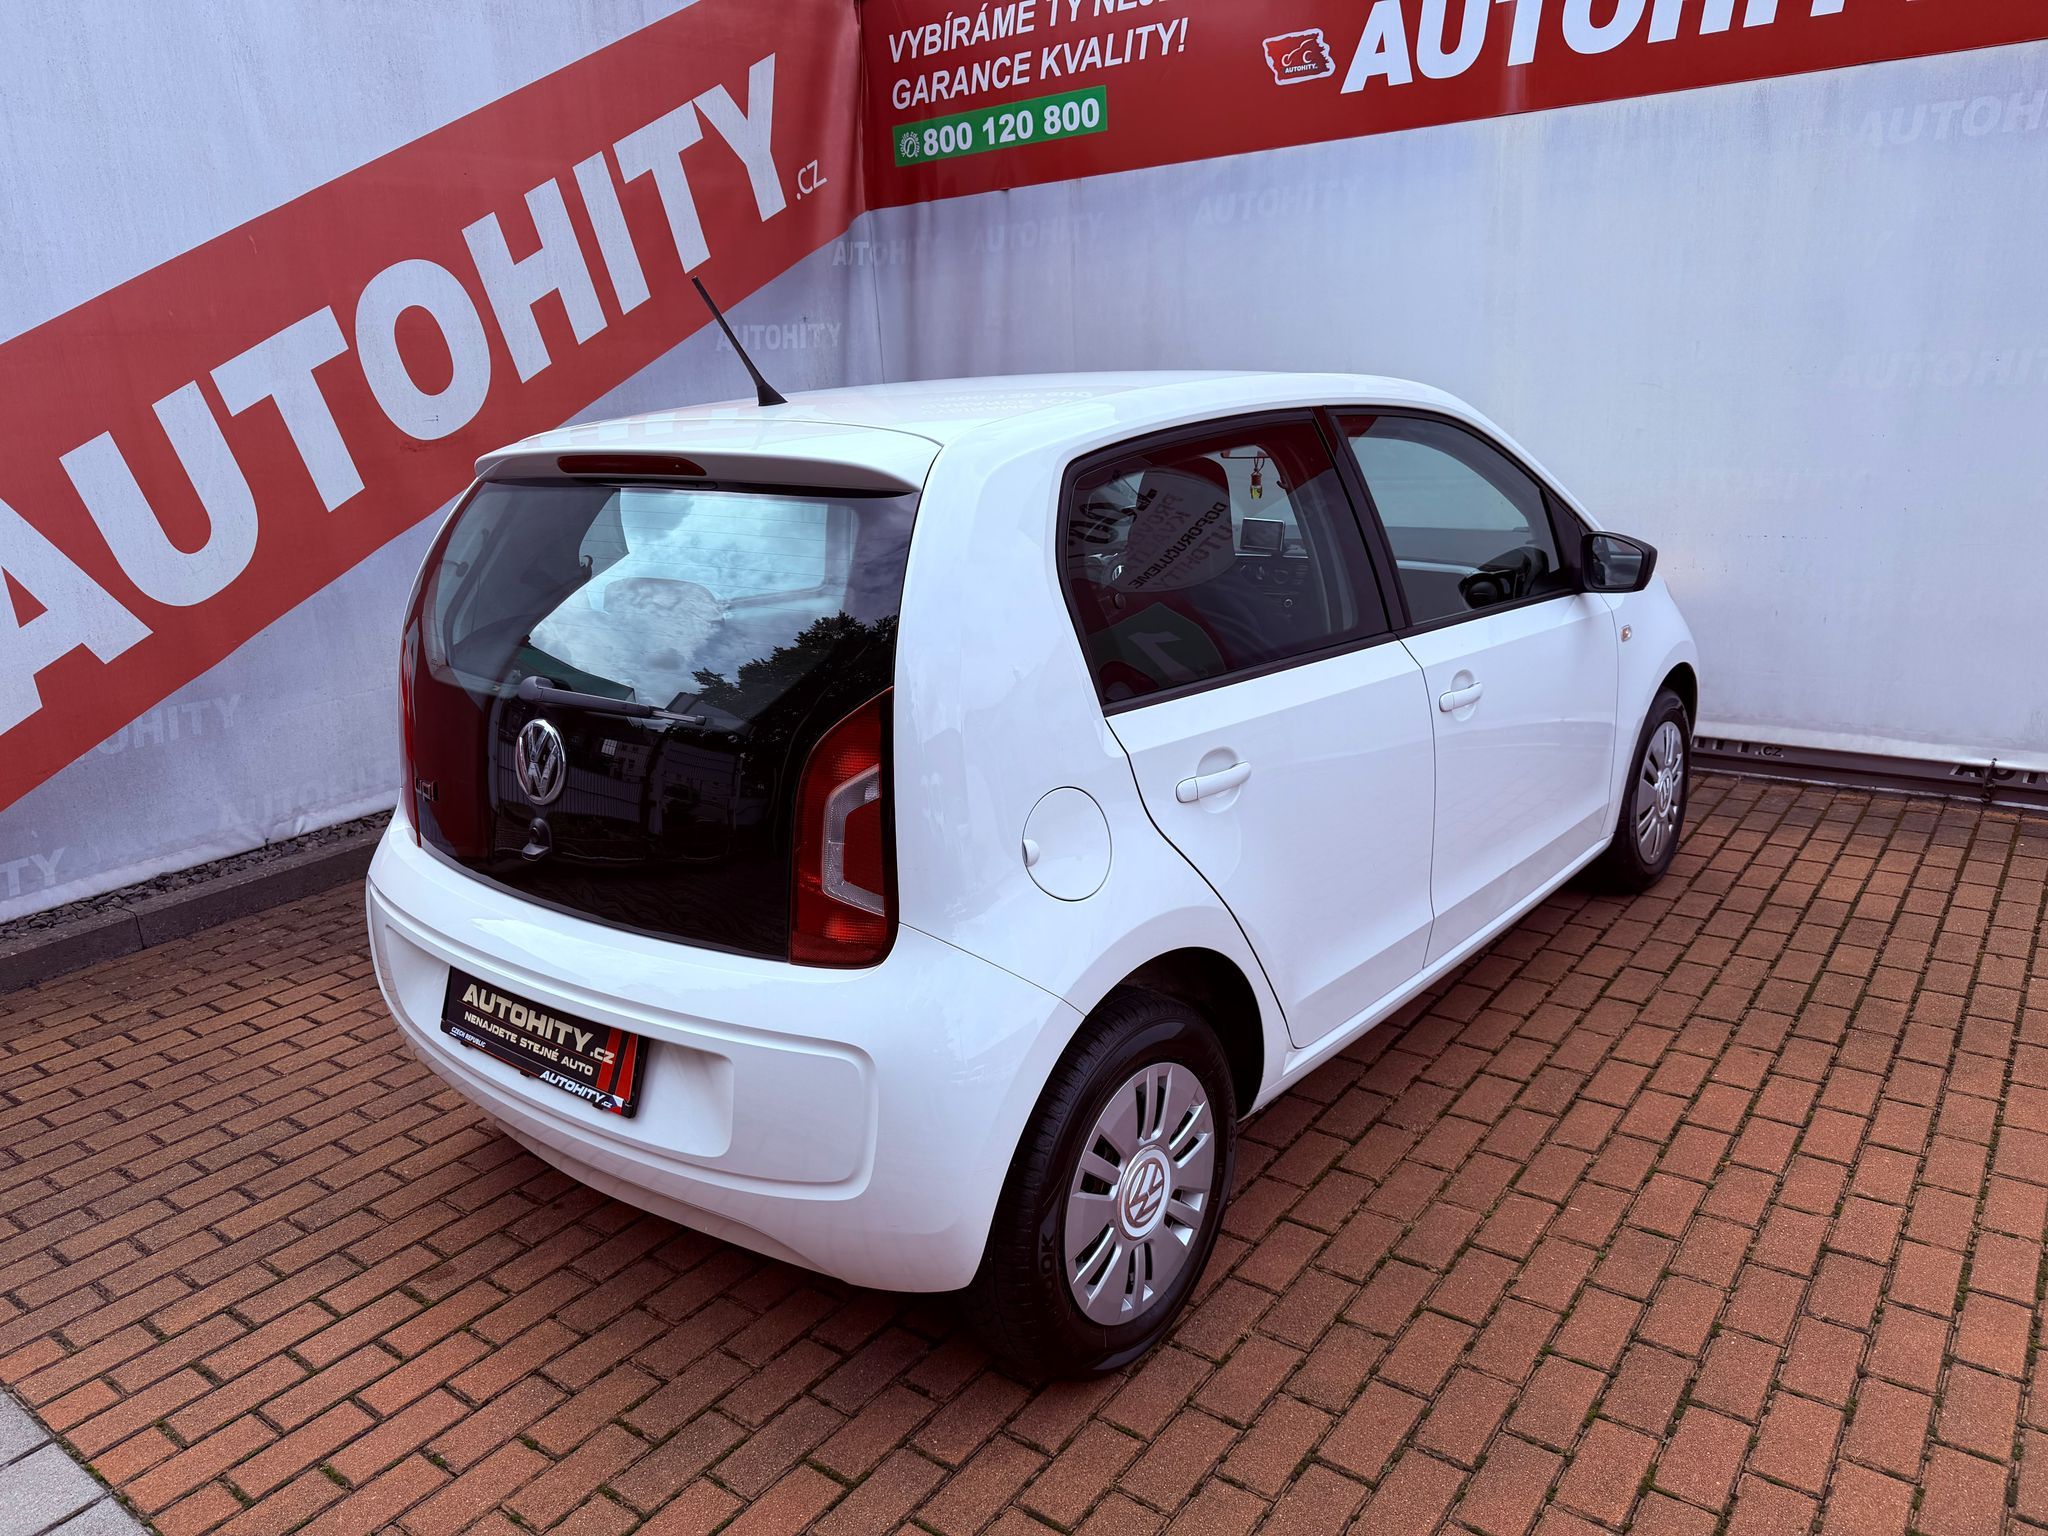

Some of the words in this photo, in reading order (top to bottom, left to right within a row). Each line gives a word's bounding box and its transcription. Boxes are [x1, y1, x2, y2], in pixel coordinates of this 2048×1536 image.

[888, 0, 1036, 64] VYBÍRÁME
[892, 51, 1032, 110] GARANCE
[1040, 17, 1189, 81] KVALITY!
[923, 121, 973, 156] 800
[982, 110, 1034, 146] 120
[1043, 97, 1101, 135] 800
[451, 1026, 465, 1038] CZECH
[465, 1033, 487, 1048] REPUBLIC
[464, 1011, 517, 1044] NENAJDETE
[519, 1037, 559, 1061] STEJNÉ
[560, 1056, 594, 1077] AUTO
